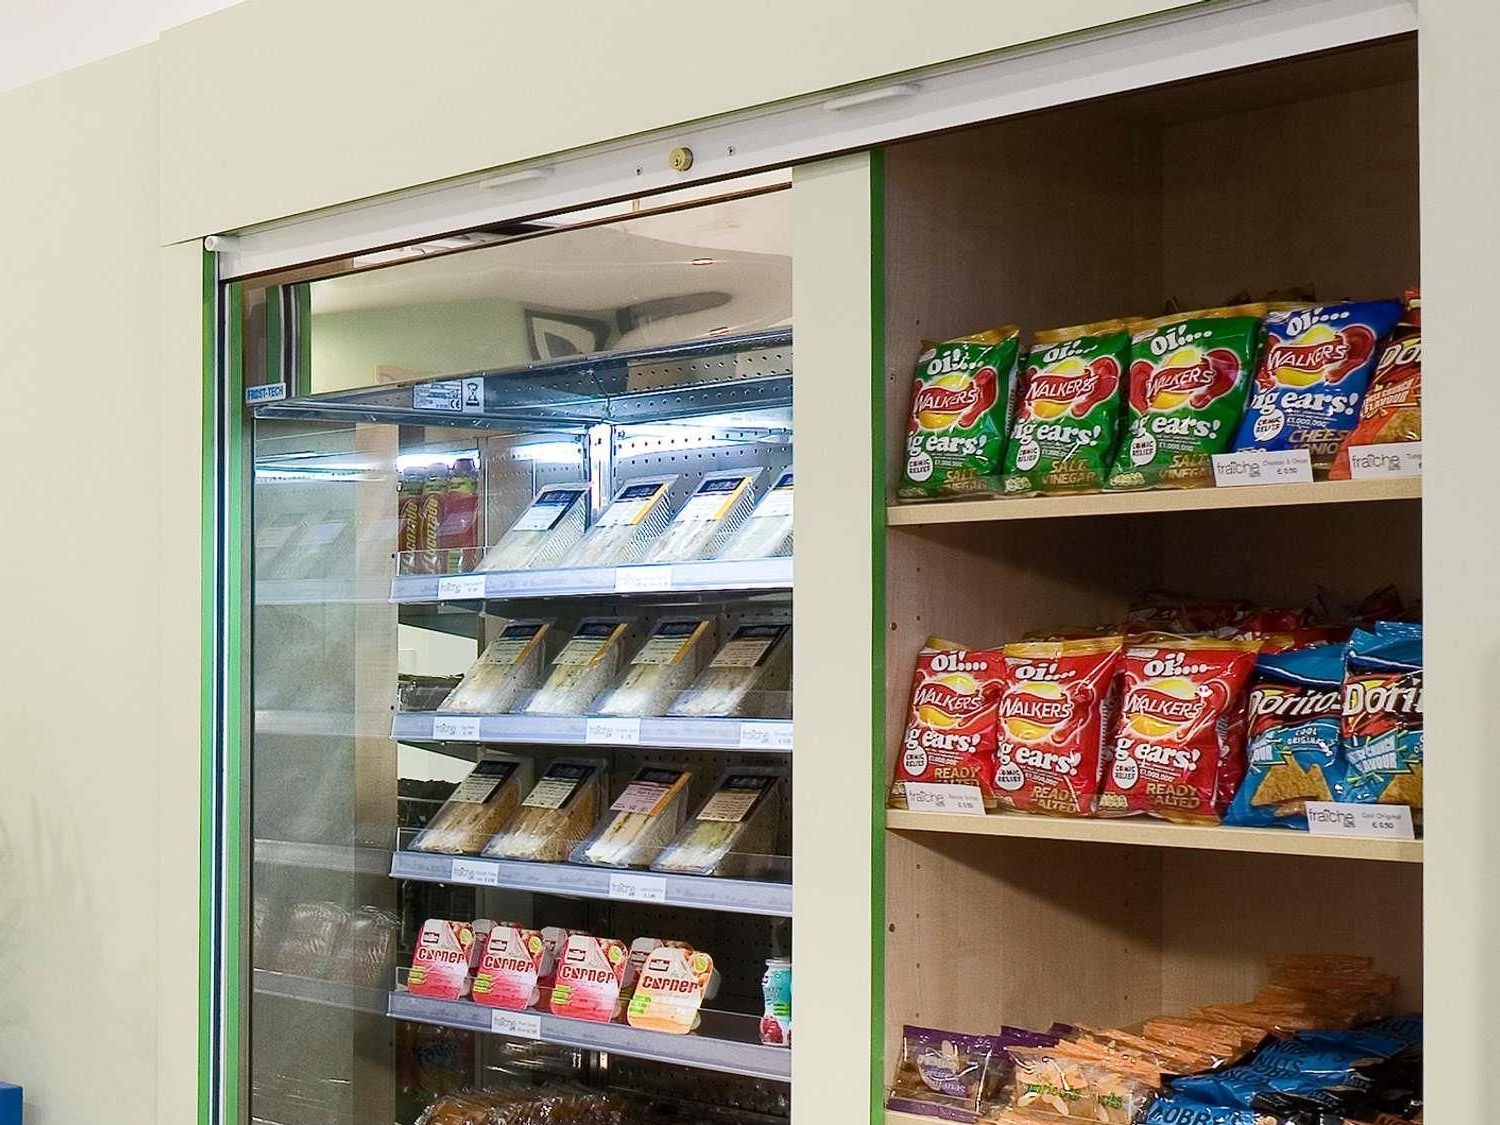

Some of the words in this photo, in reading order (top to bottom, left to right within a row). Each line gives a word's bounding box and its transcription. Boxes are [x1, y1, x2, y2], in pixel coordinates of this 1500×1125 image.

[1267, 344, 1348, 369] WALKERS
[1025, 376, 1096, 400] WALKERS
[1145, 367, 1215, 398] WALKERS
[914, 386, 980, 411] WALKERS
[1281, 391, 1358, 416] ears!
[1036, 425, 1101, 446] ears!
[1151, 416, 1220, 439] ears!
[926, 435, 987, 455] ears!
[914, 687, 984, 711] WALKERS
[999, 698, 1072, 718] WALKERS
[1123, 693, 1206, 719] WALKERS
[922, 730, 980, 753] ears!
[1015, 747, 1081, 776] ears!
[1134, 743, 1200, 771] ears!
[935, 767, 980, 778] READY
[1146, 783, 1197, 798] READY
[1033, 799, 1077, 813] ALTED
